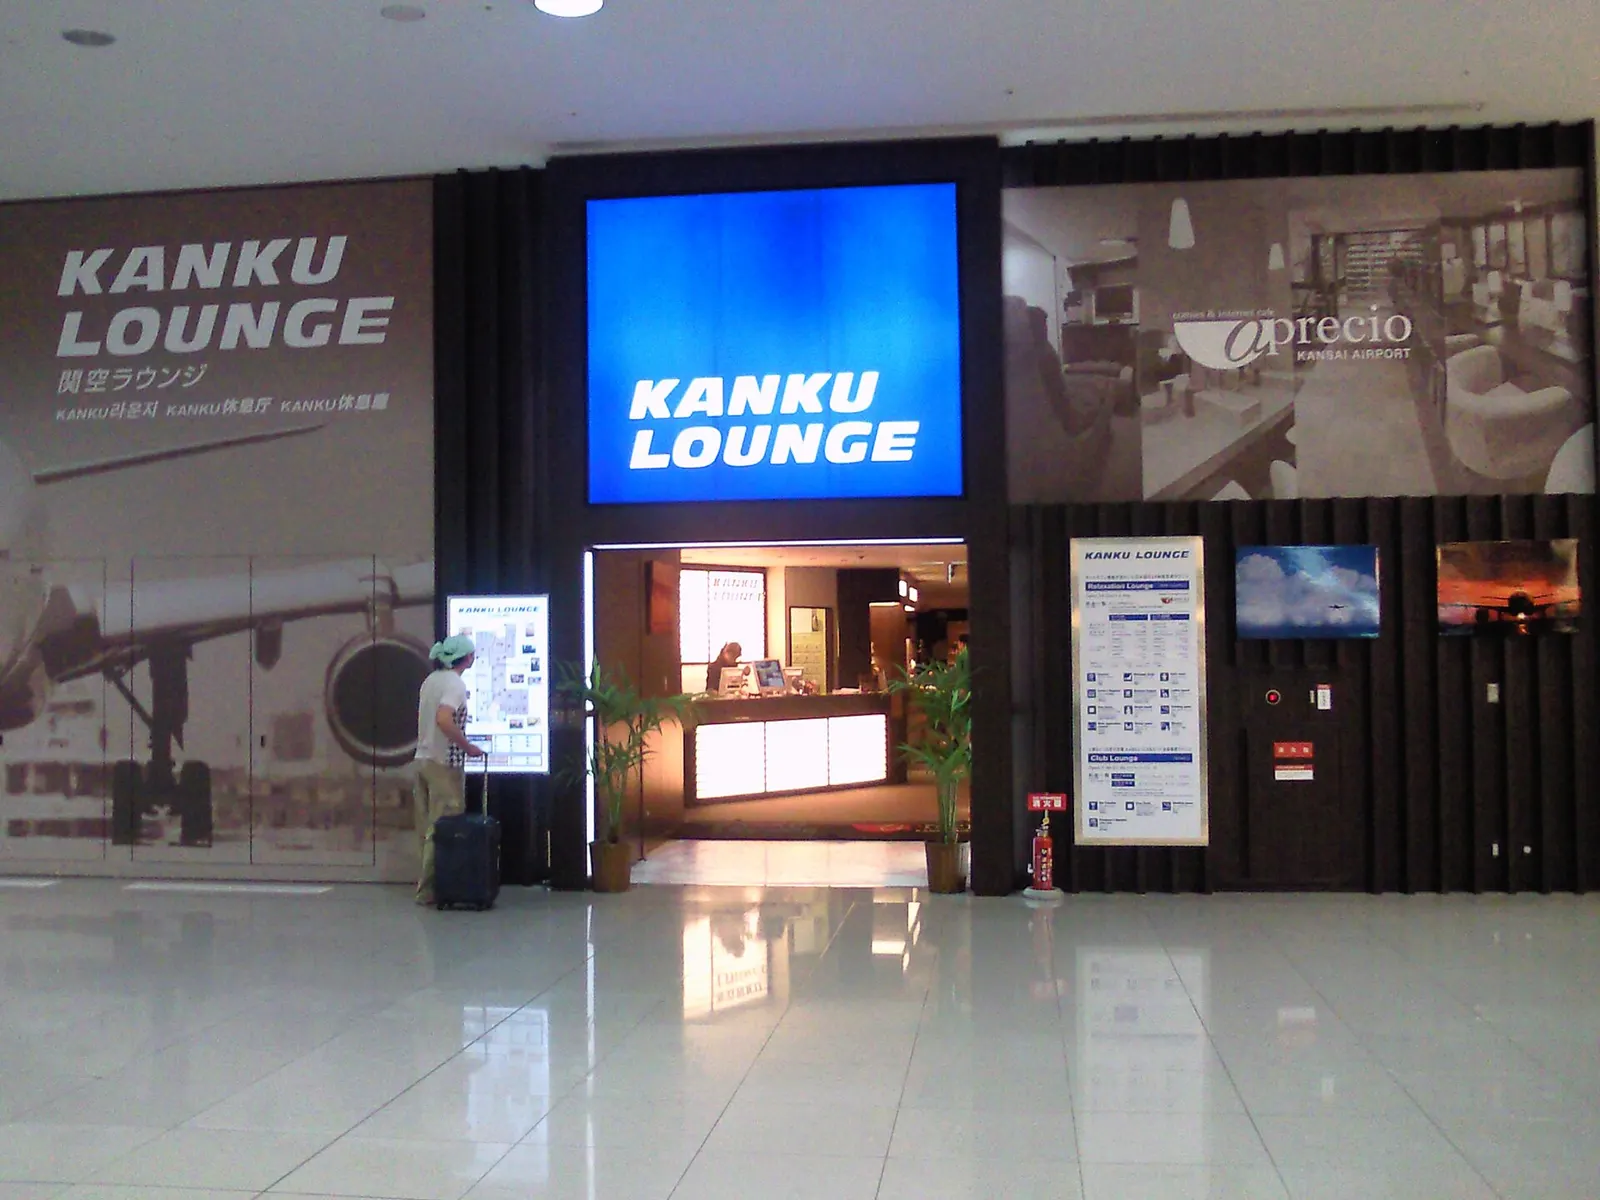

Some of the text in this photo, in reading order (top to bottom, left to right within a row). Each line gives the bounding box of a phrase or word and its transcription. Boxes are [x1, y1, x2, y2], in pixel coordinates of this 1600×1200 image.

[57, 236, 348, 297] KANKU
[56, 296, 395, 358] LOUNGE
[1225, 304, 1412, 362] aprecio
[1297, 348, 1412, 361] KANSAI AIRPORT
[57, 363, 208, 394] 関空ラウンジ
[629, 371, 880, 420] KANKU
[629, 421, 920, 469] LOUNGE
[1085, 550, 1190, 560] KANKU LOUNGE
[1126, 583, 1153, 591] Lounge
[1090, 754, 1138, 763] Club Lounge
